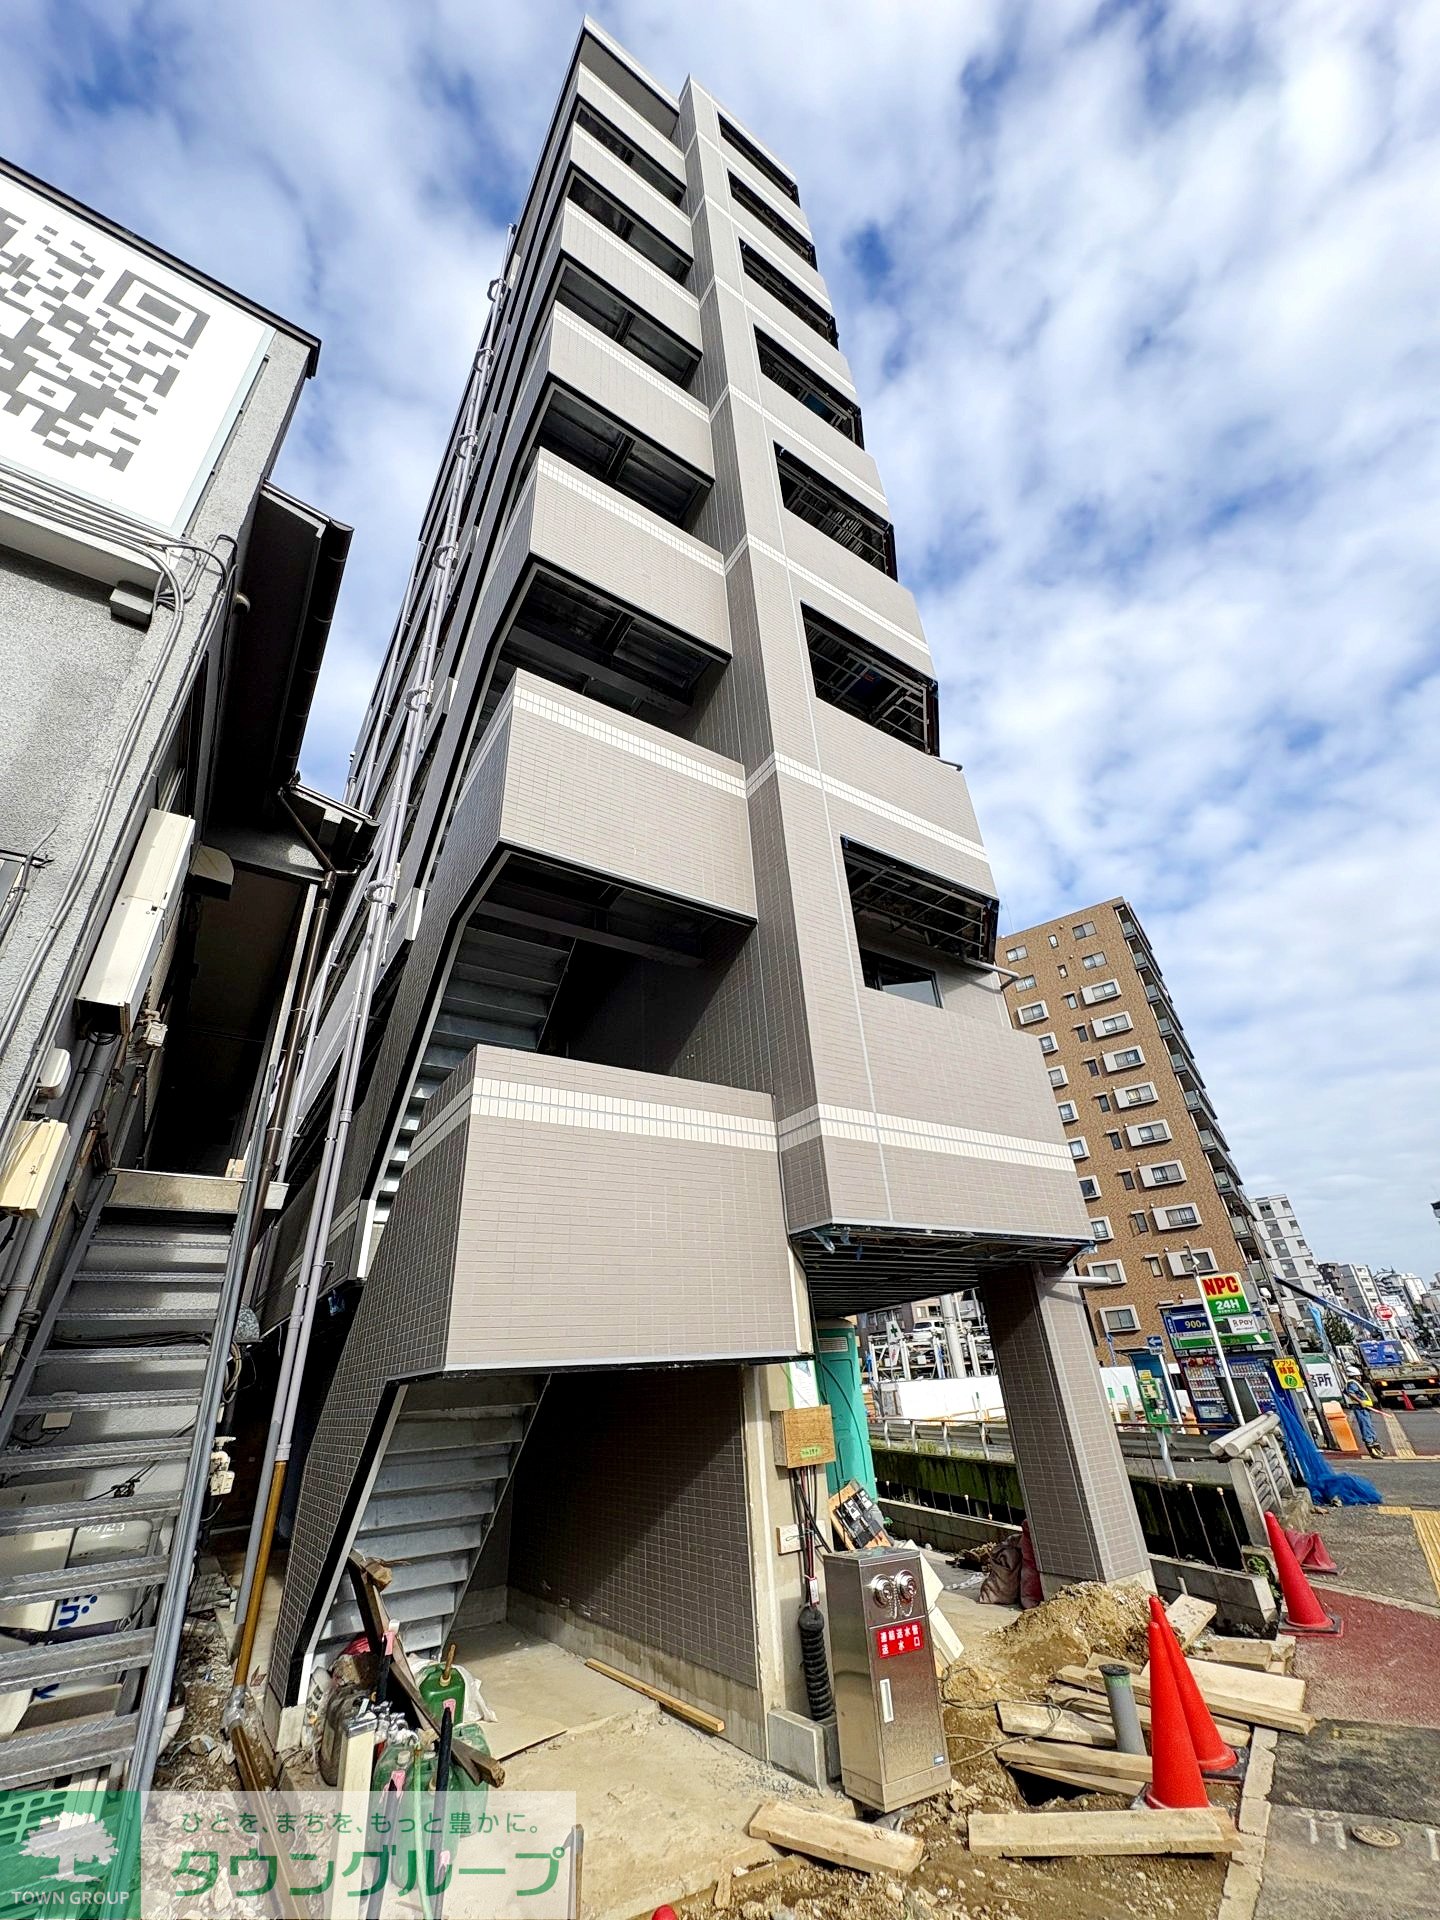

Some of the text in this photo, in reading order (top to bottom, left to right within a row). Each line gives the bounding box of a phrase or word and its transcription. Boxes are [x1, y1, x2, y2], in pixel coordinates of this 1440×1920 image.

[1201, 1275, 1239, 1296] NPC
[1215, 1298, 1240, 1310] 24H
[880, 1624, 919, 1643] 連結送水管
